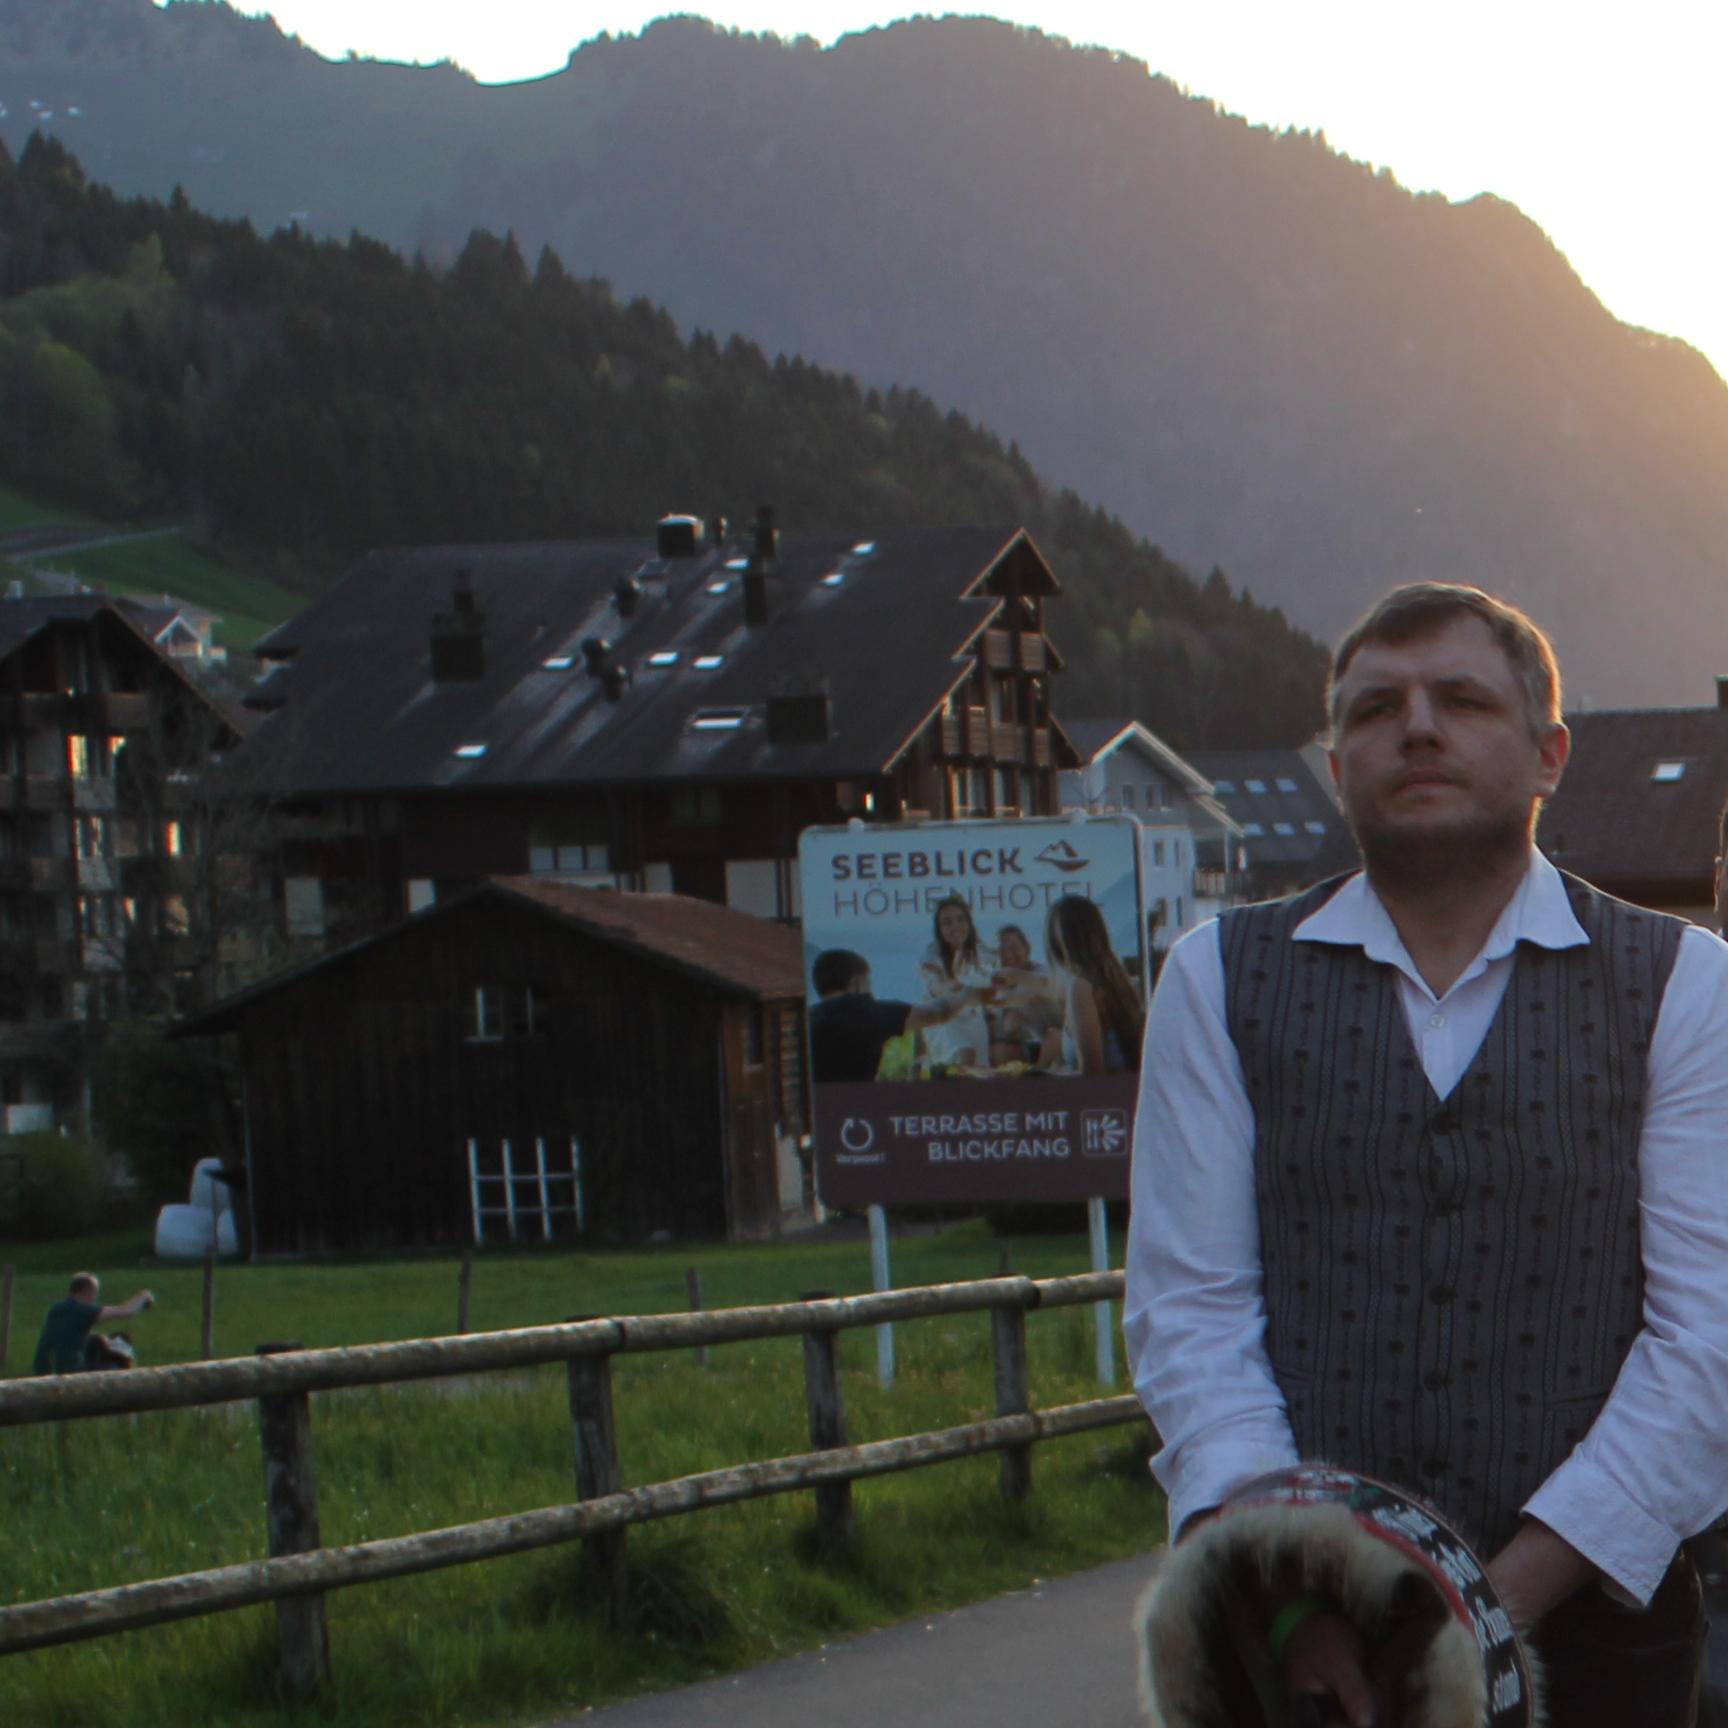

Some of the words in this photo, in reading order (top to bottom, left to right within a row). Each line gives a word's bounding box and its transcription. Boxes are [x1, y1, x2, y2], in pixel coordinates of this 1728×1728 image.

[831, 848, 1023, 880] SEEBLICK
[888, 1112, 1018, 1137] TERRASSE
[1024, 1110, 1070, 1133] MIT
[927, 1137, 1071, 1162] BLICKFANG
